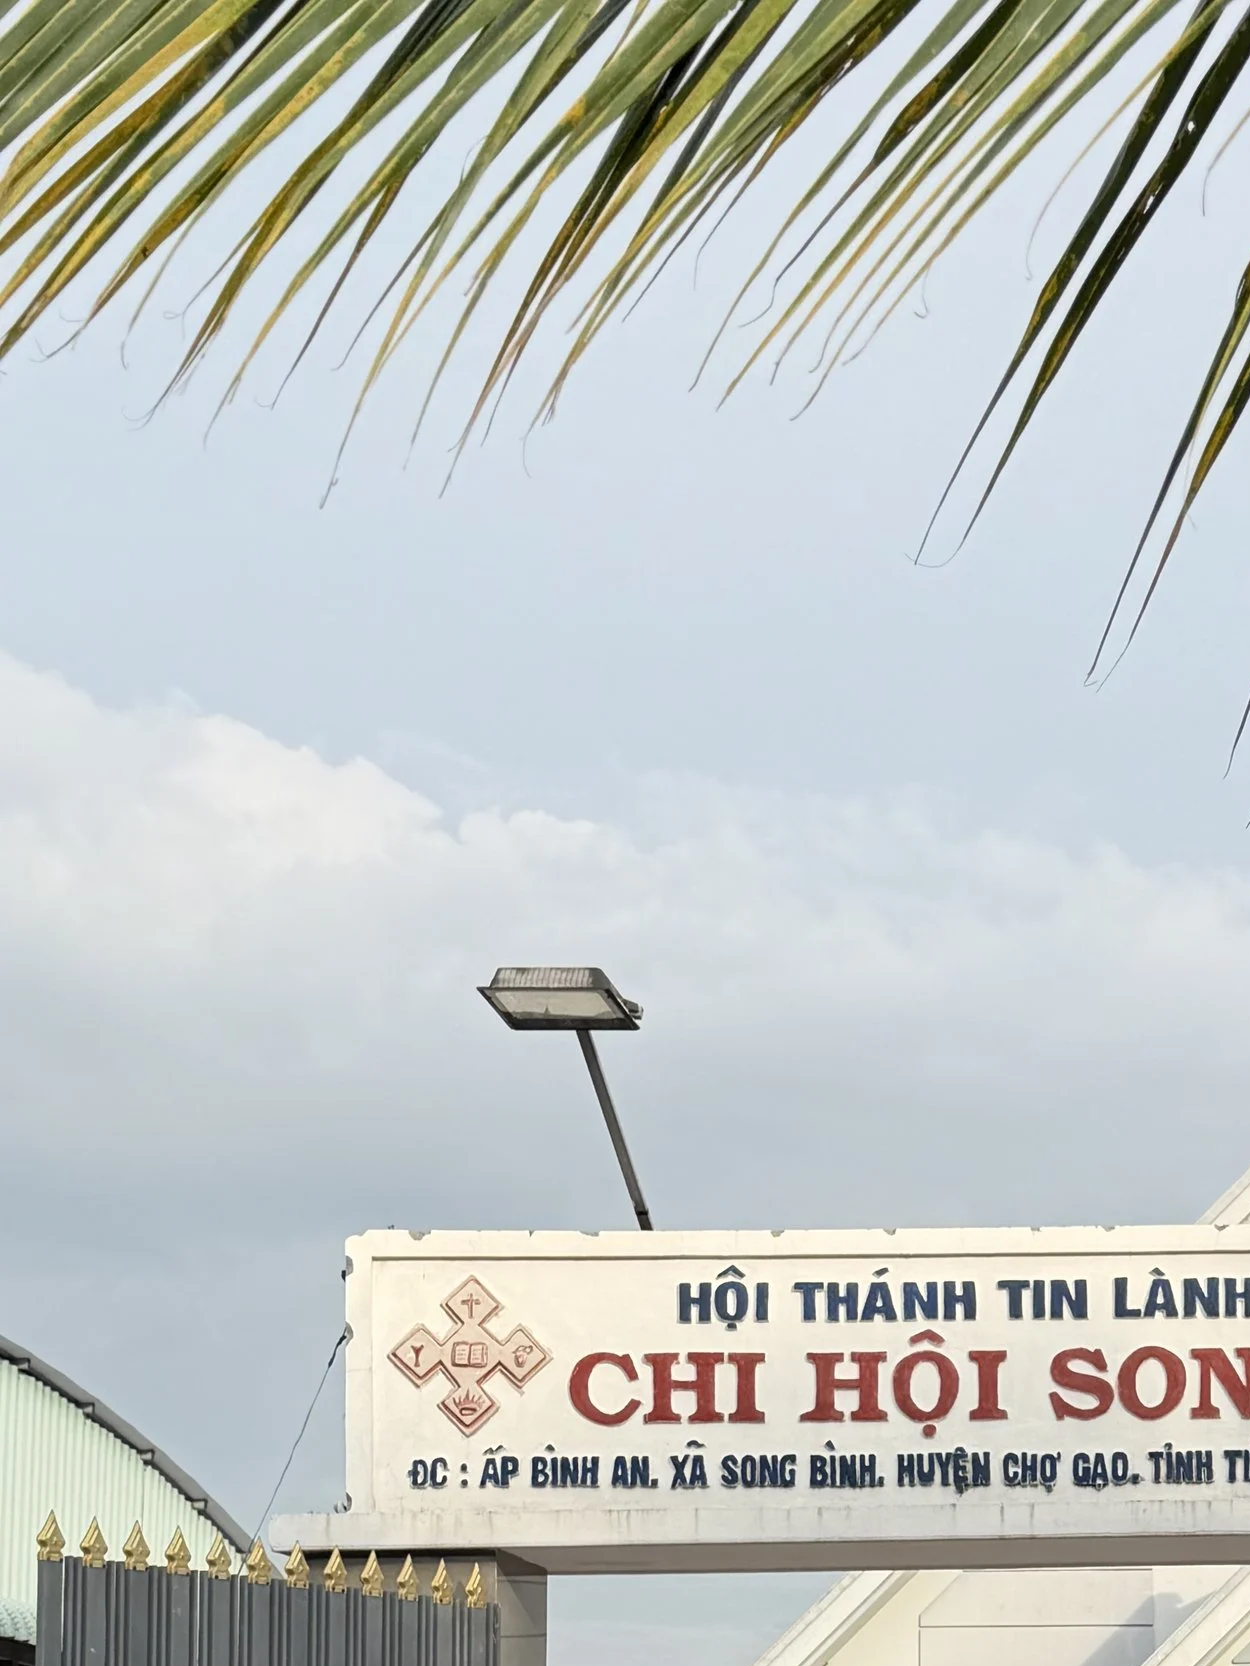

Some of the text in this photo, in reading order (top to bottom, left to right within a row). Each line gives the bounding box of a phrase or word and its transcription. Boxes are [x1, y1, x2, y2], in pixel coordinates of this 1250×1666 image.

[677, 1265, 769, 1330] HỘI
[791, 1267, 977, 1322] THÁNH
[997, 1279, 1089, 1321] TIN
[568, 1352, 766, 1427] CHI
[800, 1330, 1009, 1438] HỘI
[480, 1444, 519, 1489] ẤP
[720, 1453, 797, 1489] SONG
[1002, 1451, 1062, 1493] CHỢ
[1148, 1443, 1215, 1485] TỈNH
